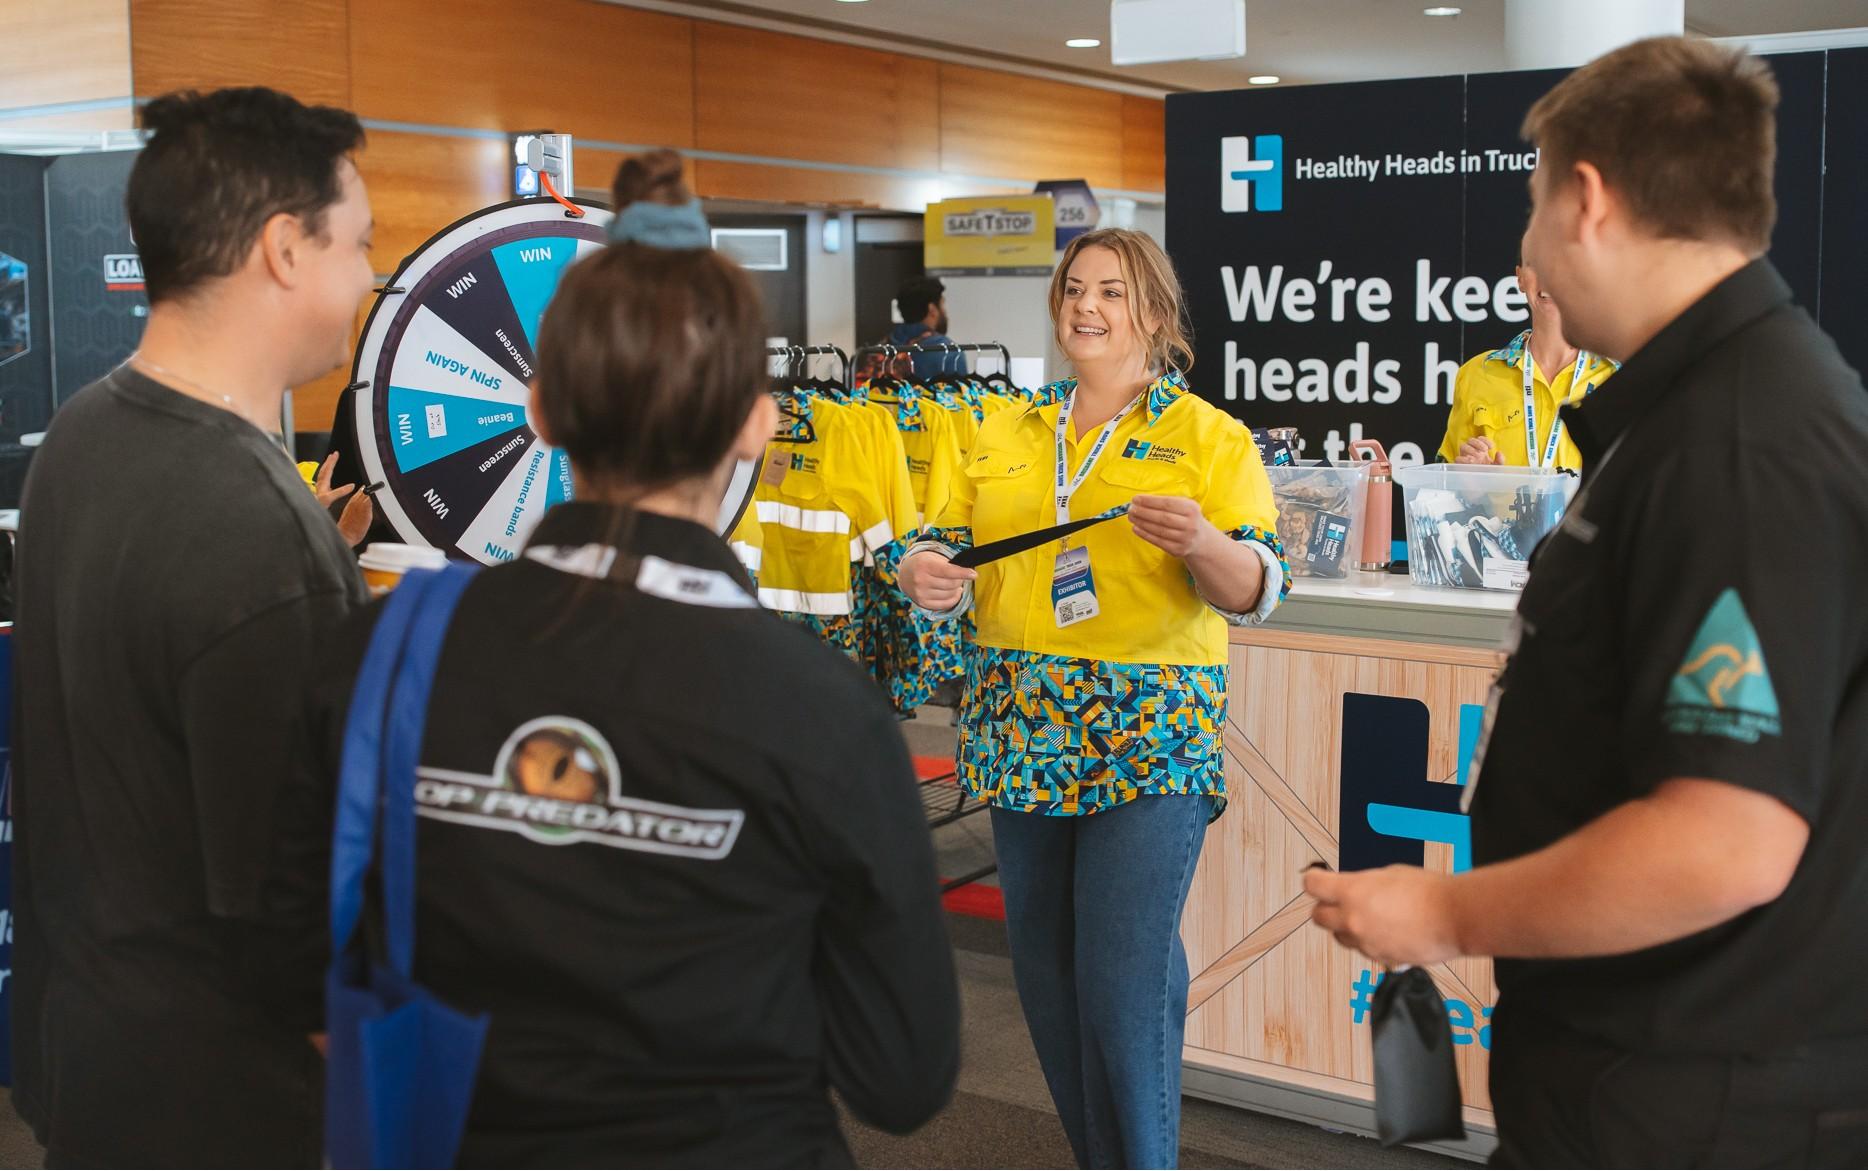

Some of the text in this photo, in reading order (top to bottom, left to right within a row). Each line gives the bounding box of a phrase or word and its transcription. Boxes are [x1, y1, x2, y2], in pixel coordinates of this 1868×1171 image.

[1296, 154, 1380, 182] Healthy
[1385, 151, 1456, 176] Heads
[1460, 150, 1481, 173] in
[1059, 208, 1085, 222] 256
[519, 246, 552, 263] WIN
[446, 271, 478, 299] WIN
[1220, 258, 1529, 323] We’re kee
[495, 328, 533, 378] Sunscreen
[425, 350, 502, 390] SPIN AGAIN
[1224, 340, 1402, 404] heads
[397, 413, 414, 446] WIN
[478, 412, 514, 427] Beanie
[478, 434, 525, 473] Sunscreen
[1148, 451, 1176, 460] Heads
[1151, 444, 1187, 457] Healthy
[423, 488, 450, 520] WIN
[505, 450, 545, 537] Resistance bands
[1057, 580, 1087, 595] EXHIBITOR
[481, 788, 729, 847] PREDATOR
